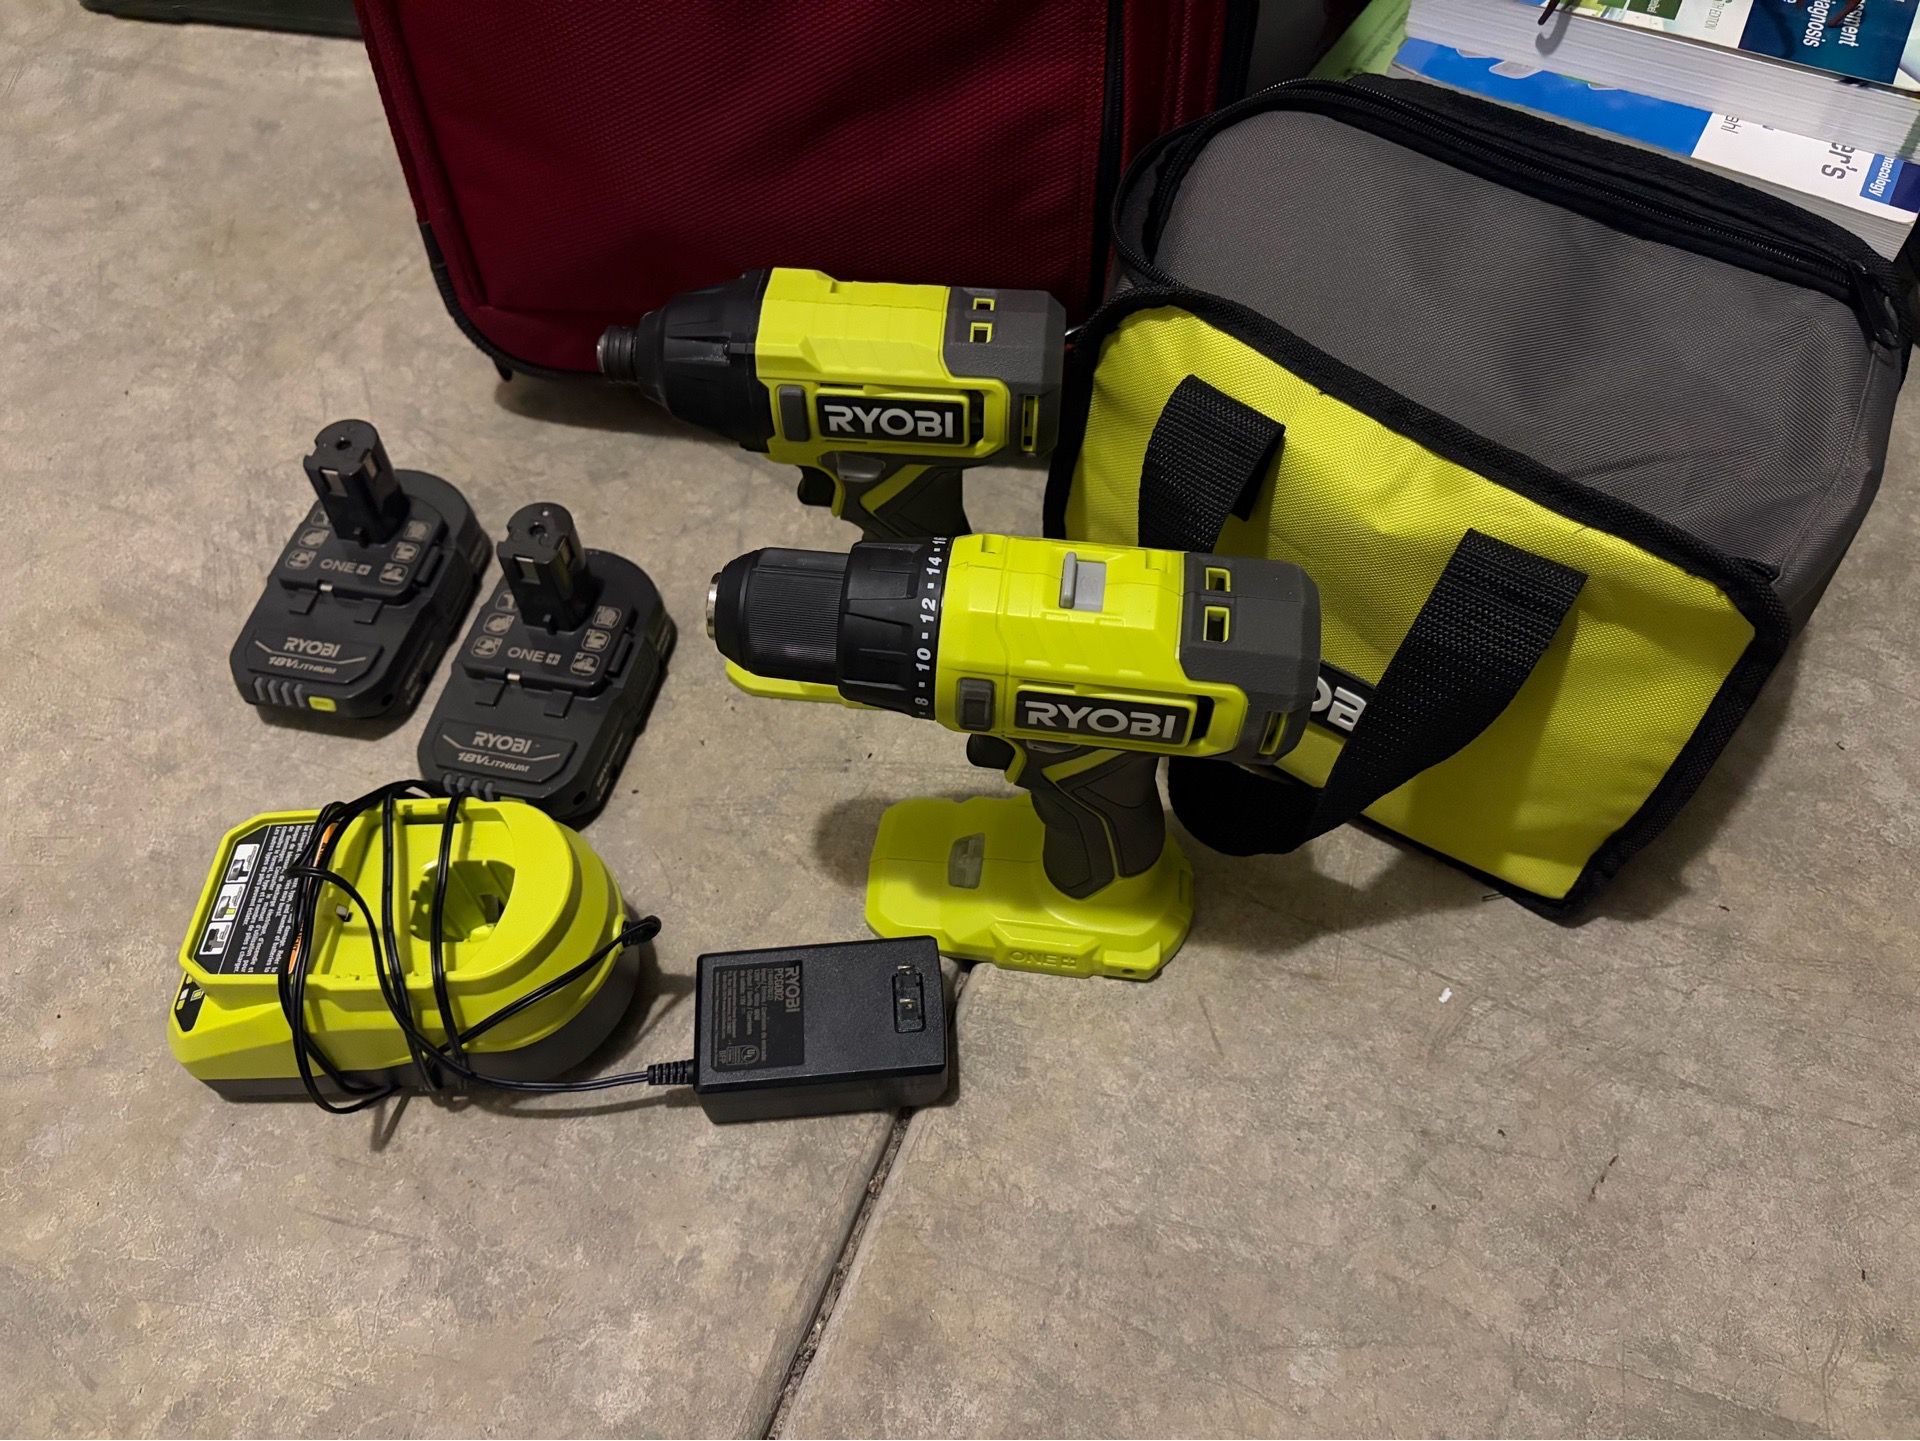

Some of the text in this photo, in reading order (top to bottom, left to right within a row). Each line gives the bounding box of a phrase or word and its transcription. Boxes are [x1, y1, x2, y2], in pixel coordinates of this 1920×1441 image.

[824, 405, 953, 439] RYOBI
[926, 557, 942, 575] 14
[920, 598, 936, 623] 12
[284, 637, 341, 658] RYOBI
[915, 647, 931, 671] 10
[1025, 701, 1176, 739] RYOBI
[472, 731, 532, 754] RYOBI
[785, 965, 800, 1013] RYOBI
